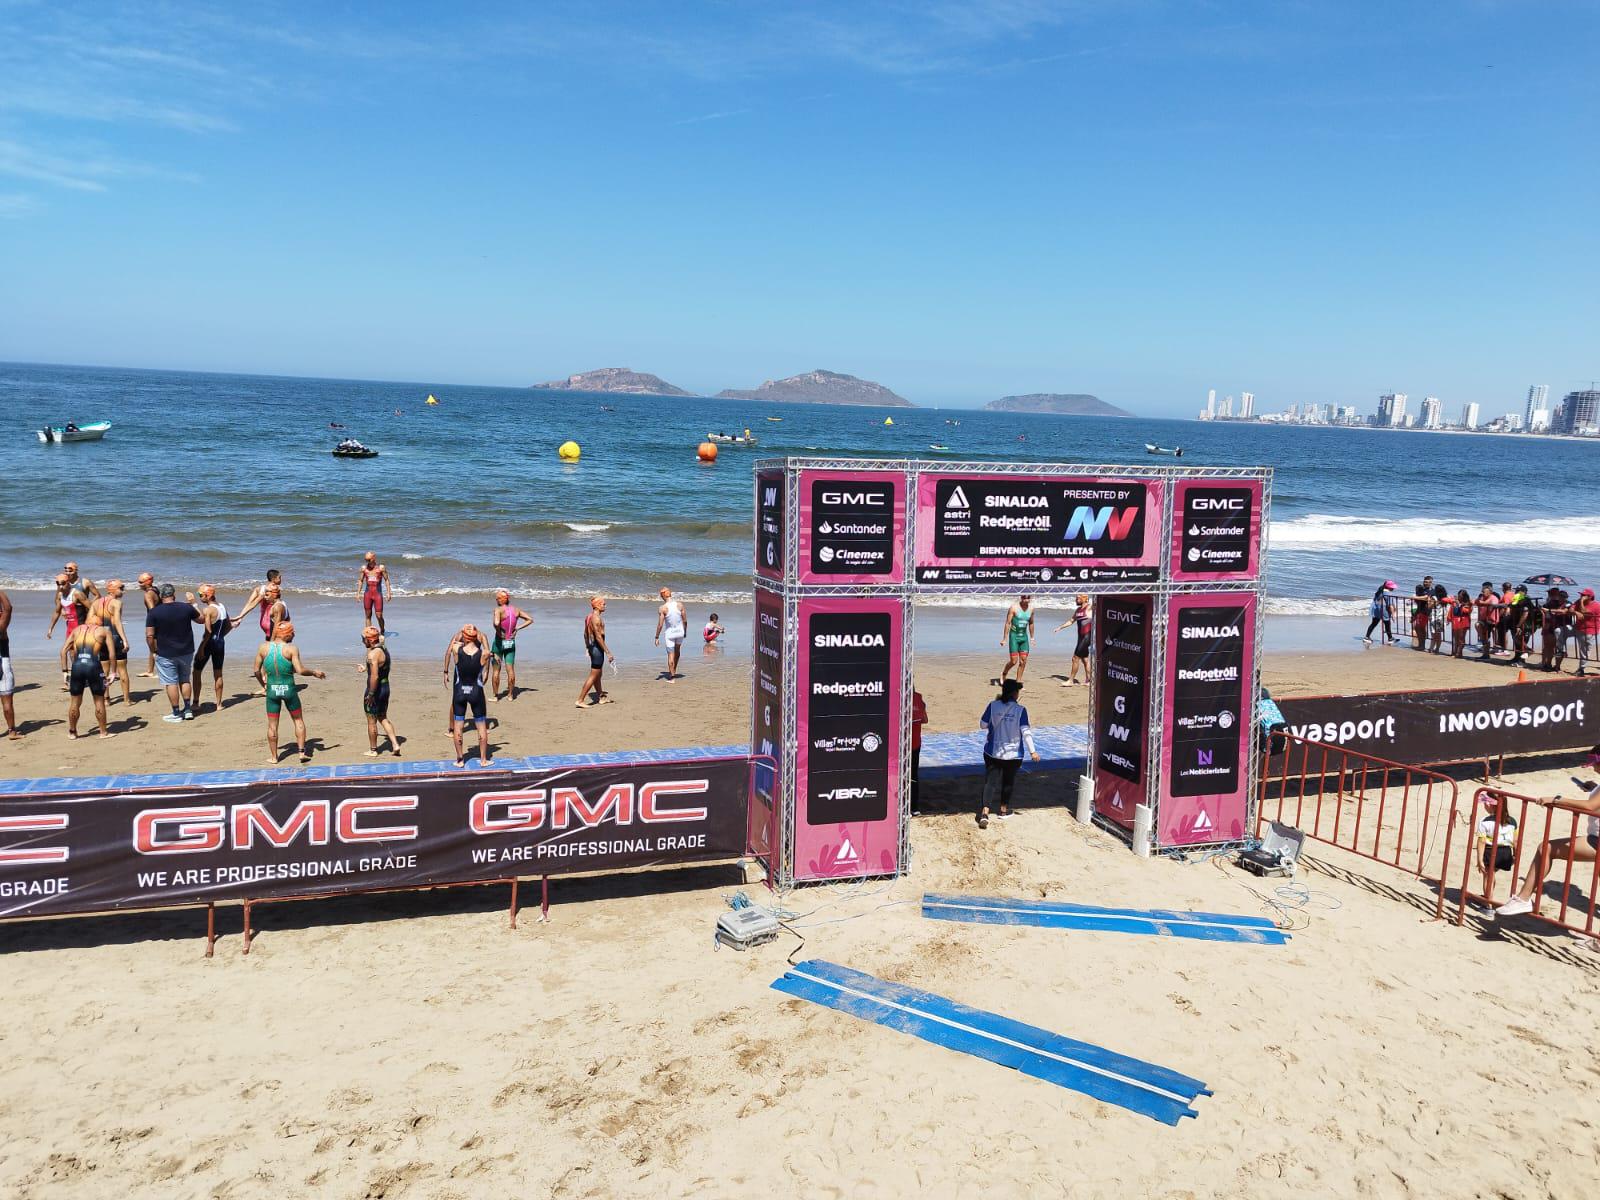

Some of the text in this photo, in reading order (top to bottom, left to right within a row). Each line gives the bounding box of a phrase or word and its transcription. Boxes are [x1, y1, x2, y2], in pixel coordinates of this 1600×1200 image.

[822, 492, 885, 505] GMC
[1063, 489, 1130, 499] PRESENTED BY
[984, 495, 1049, 508] SINALOA
[1192, 498, 1244, 510] GMC
[944, 509, 971, 519] astri
[833, 522, 887, 535] Santander
[1201, 525, 1245, 536] Santander
[835, 549, 885, 559] Cinemex
[979, 546, 1094, 555] BIENVENIDOS TRIATLETAS
[1201, 549, 1242, 559] Cinemex
[976, 570, 1007, 578] GMC
[760, 613, 779, 629] GMC
[1106, 609, 1142, 625] GMC
[1181, 626, 1240, 639] SINALOA
[814, 634, 885, 647] SINALOA
[1107, 668, 1138, 685] REWARDS
[1284, 714, 1395, 744] vasport
[818, 787, 878, 801] VIBRA
[469, 779, 709, 835] GMC
[133, 795, 419, 855] GMC
[472, 834, 706, 863] WE ARE PROFESSIONAL GRADE
[137, 855, 417, 888] WE ARE PROFESSIONAL GRADE
[0, 877, 69, 897] GRADE
